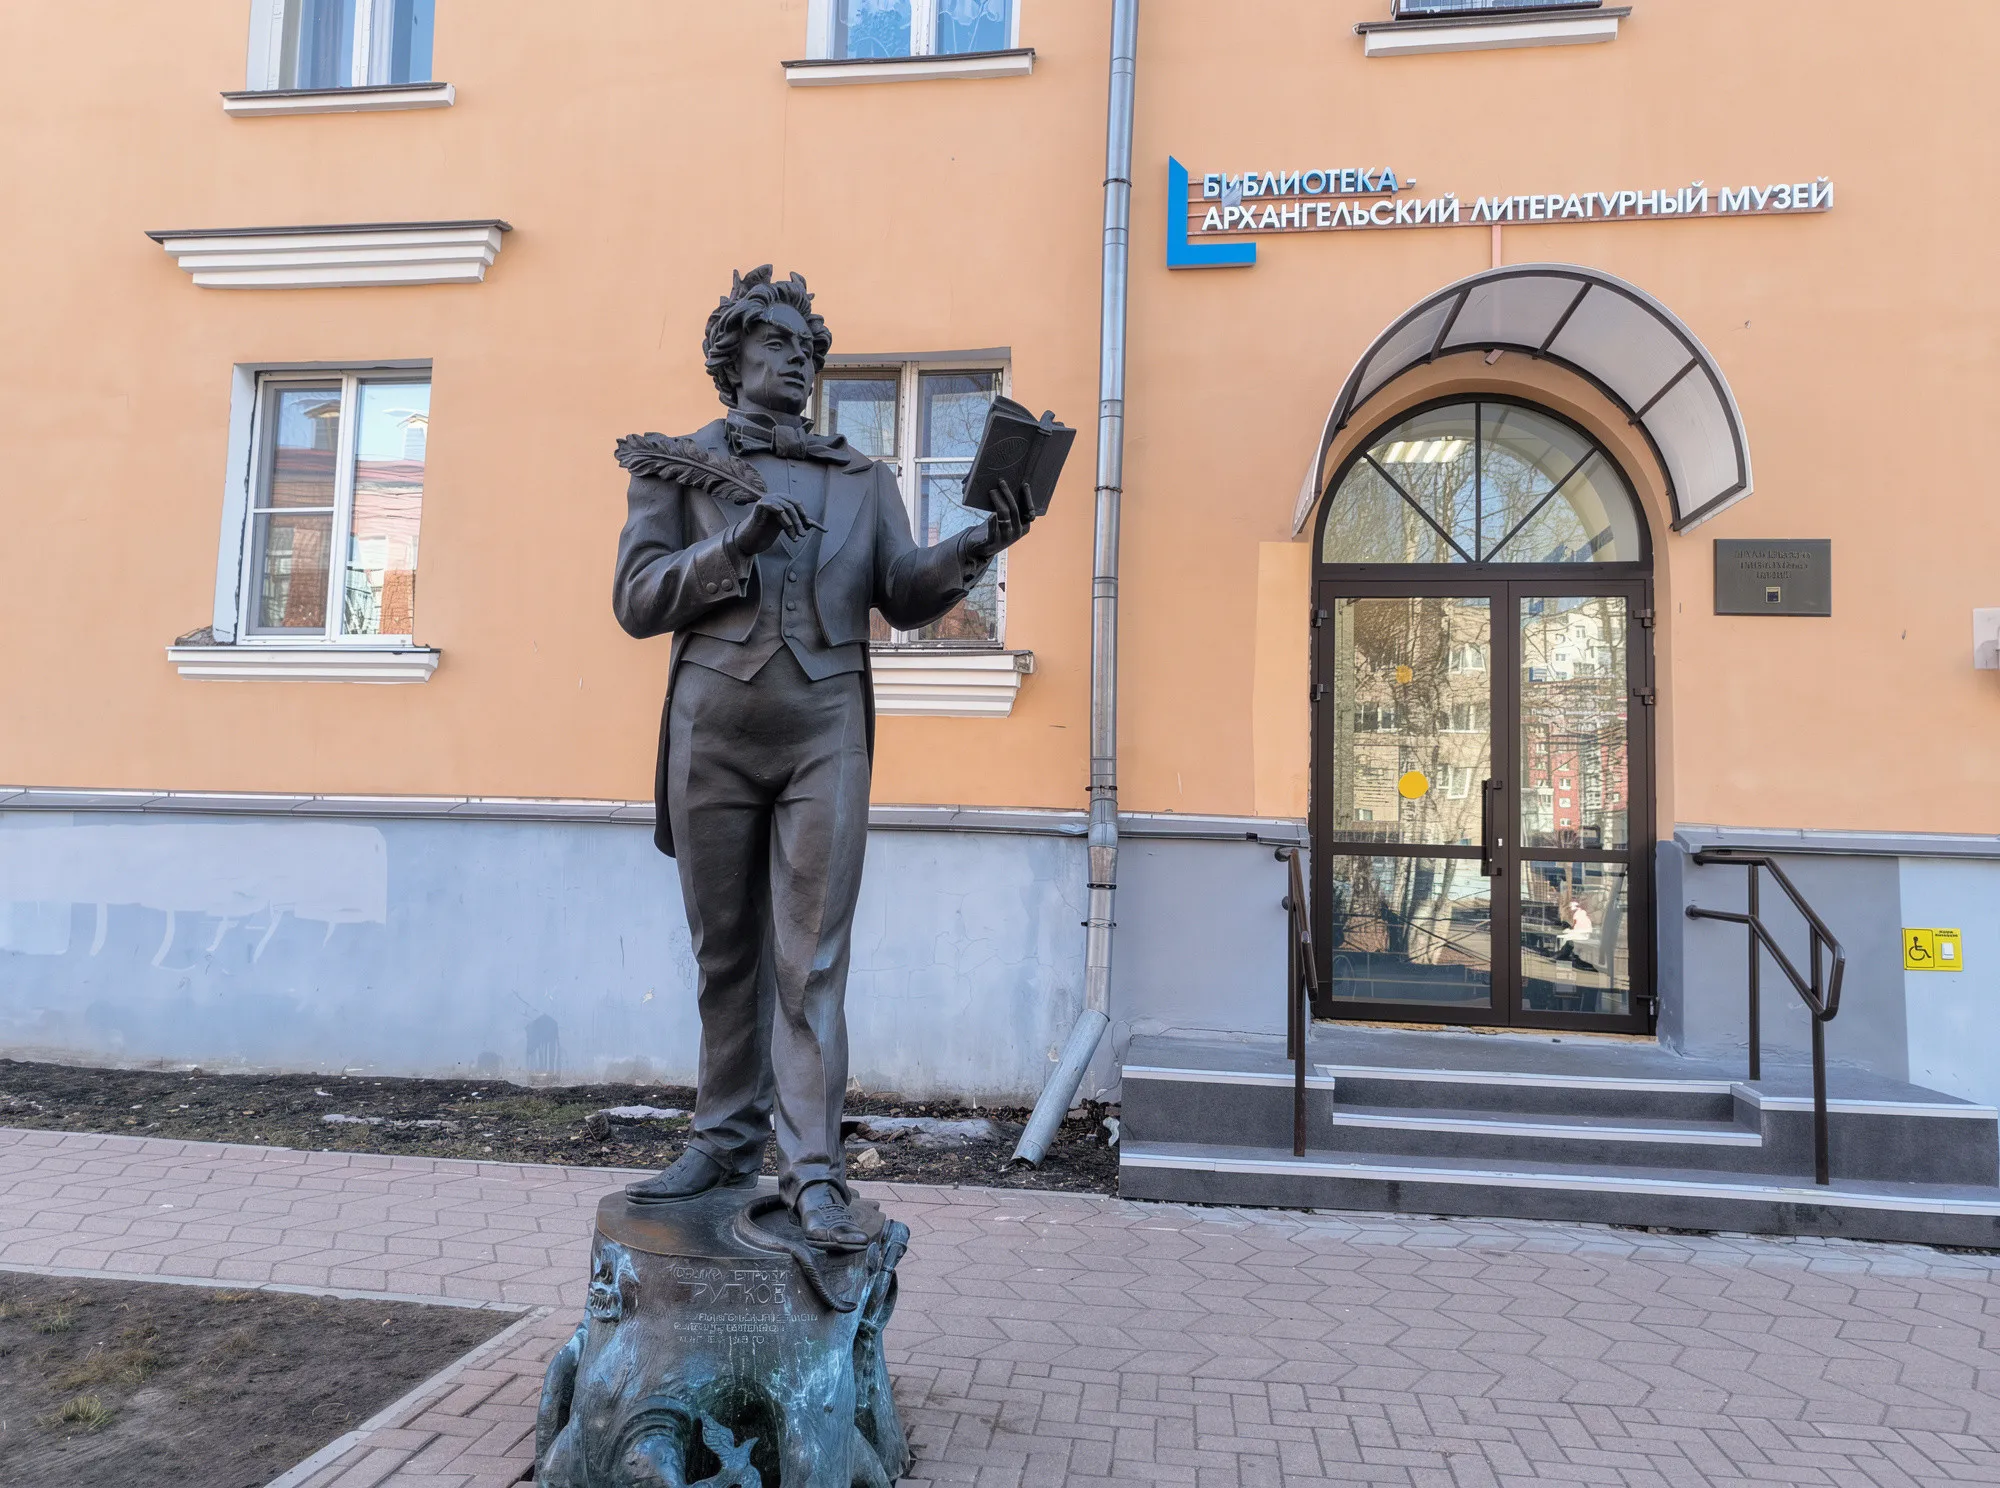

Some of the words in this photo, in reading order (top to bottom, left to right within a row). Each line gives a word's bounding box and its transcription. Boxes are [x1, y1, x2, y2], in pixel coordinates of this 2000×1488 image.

[1202, 192, 1460, 230] АРХАНГЕЛЬСКИЙ
[1470, 180, 1708, 222] ЛИТЕРАТУРНЫЙ
[1720, 175, 1834, 212] МУЗЕЙ
[1203, 166, 1399, 199] БИБЛИОТЕКА
